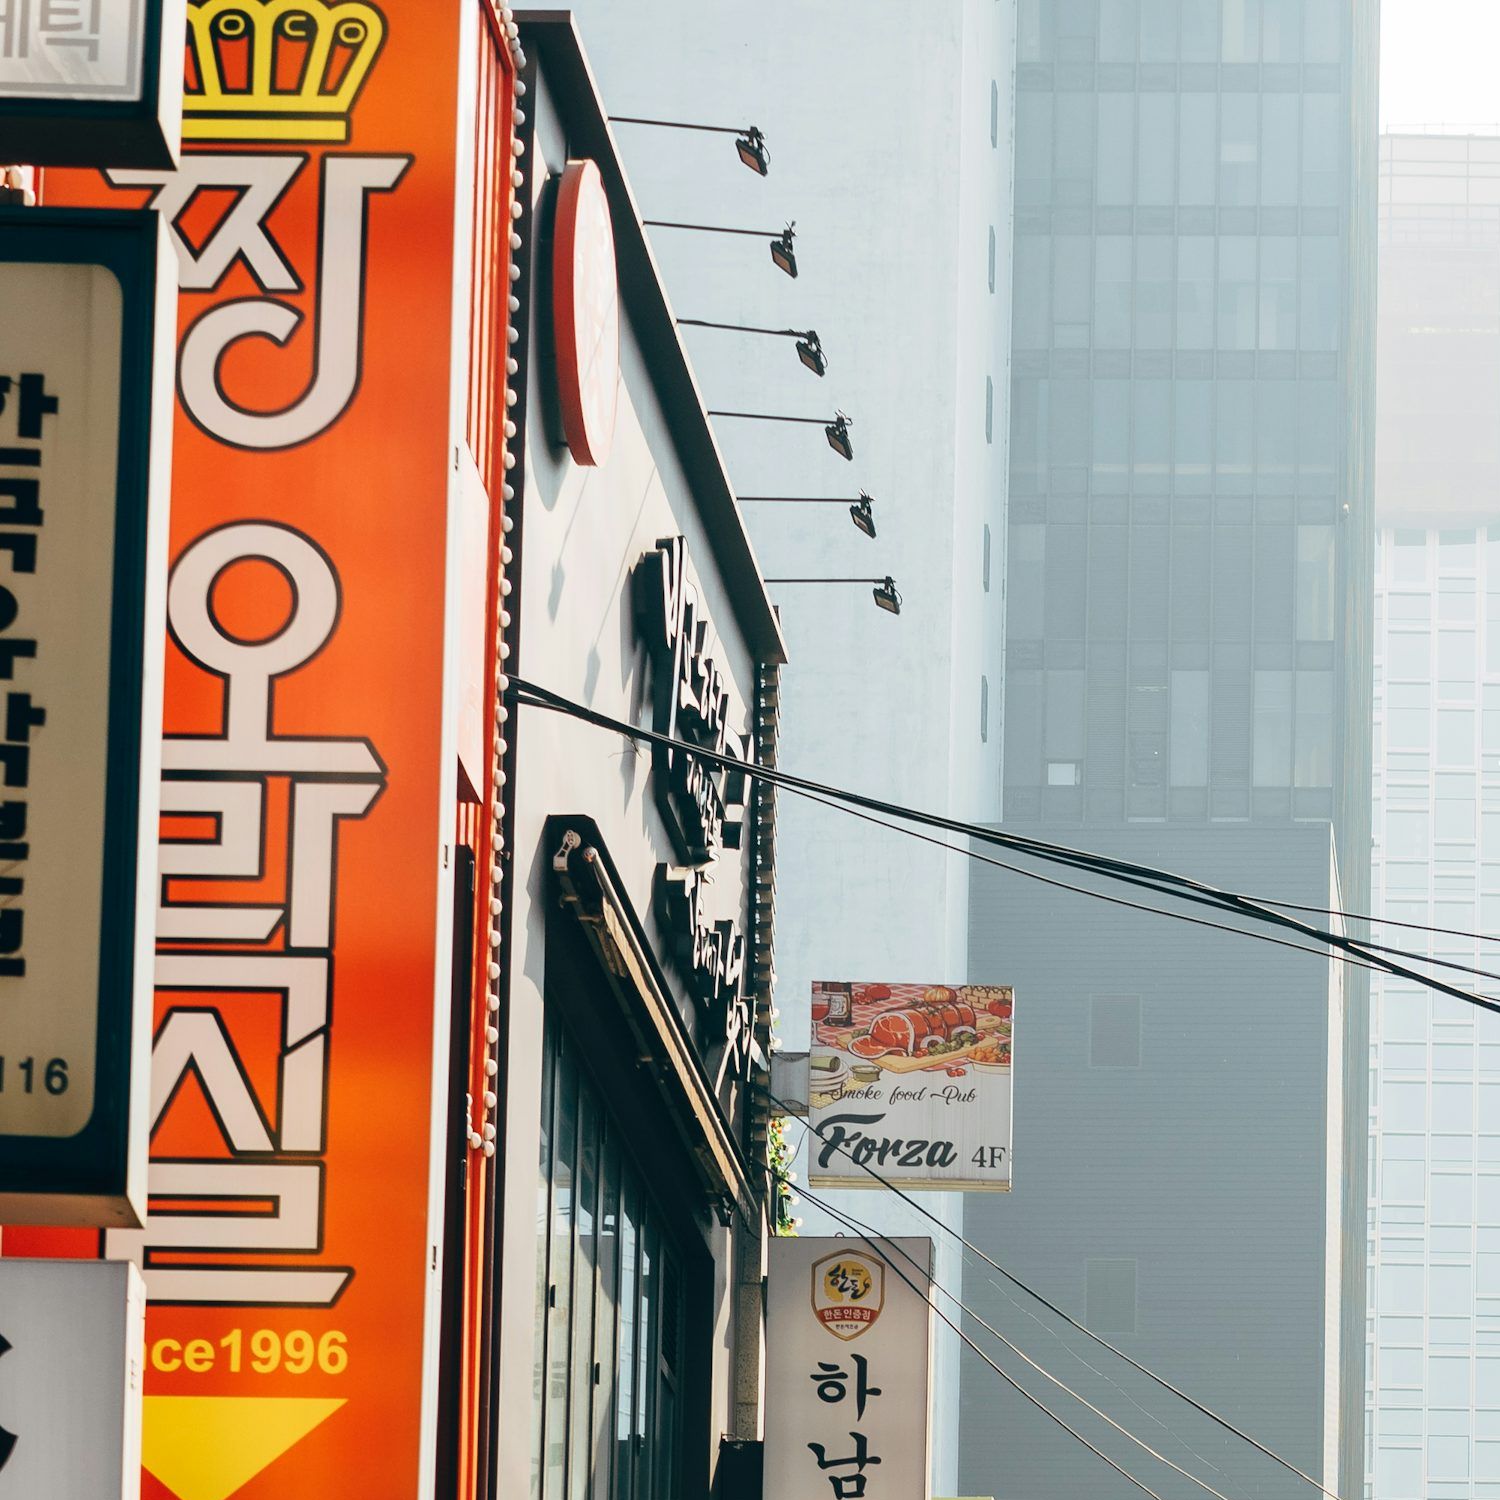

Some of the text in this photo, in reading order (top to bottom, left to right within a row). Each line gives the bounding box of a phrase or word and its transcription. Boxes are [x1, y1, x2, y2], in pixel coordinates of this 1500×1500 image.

[817, 1081, 979, 1106] Smoke food Pub
[815, 1112, 1007, 1172] Forza 4F
[143, 1328, 350, 1377] ce1996
[807, 1353, 882, 1500] 하남
